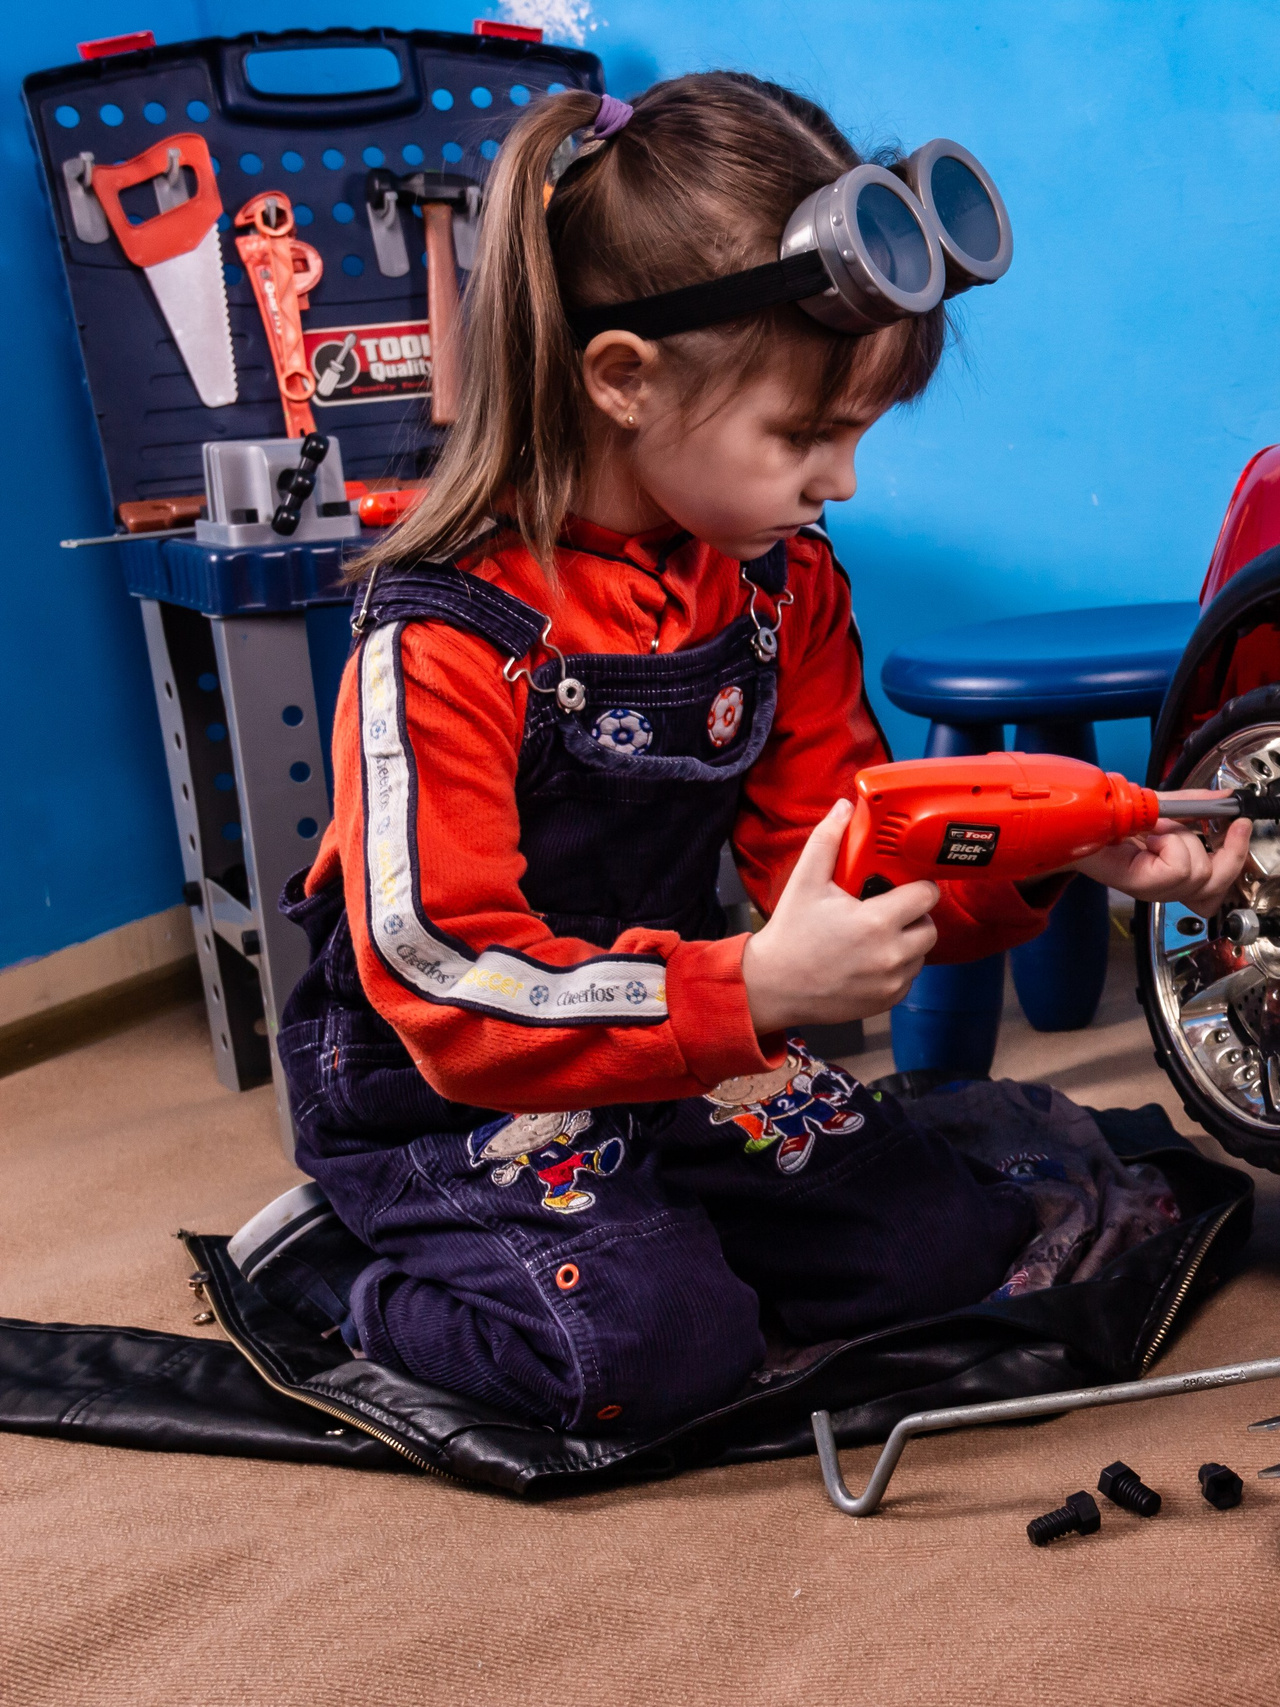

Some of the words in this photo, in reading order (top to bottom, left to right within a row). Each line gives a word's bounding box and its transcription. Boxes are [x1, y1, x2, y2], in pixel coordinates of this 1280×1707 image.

[965, 831, 993, 840] Tool
[950, 843, 987, 853] Bick-
[947, 851, 978, 860] iron
[463, 967, 525, 998] occer
